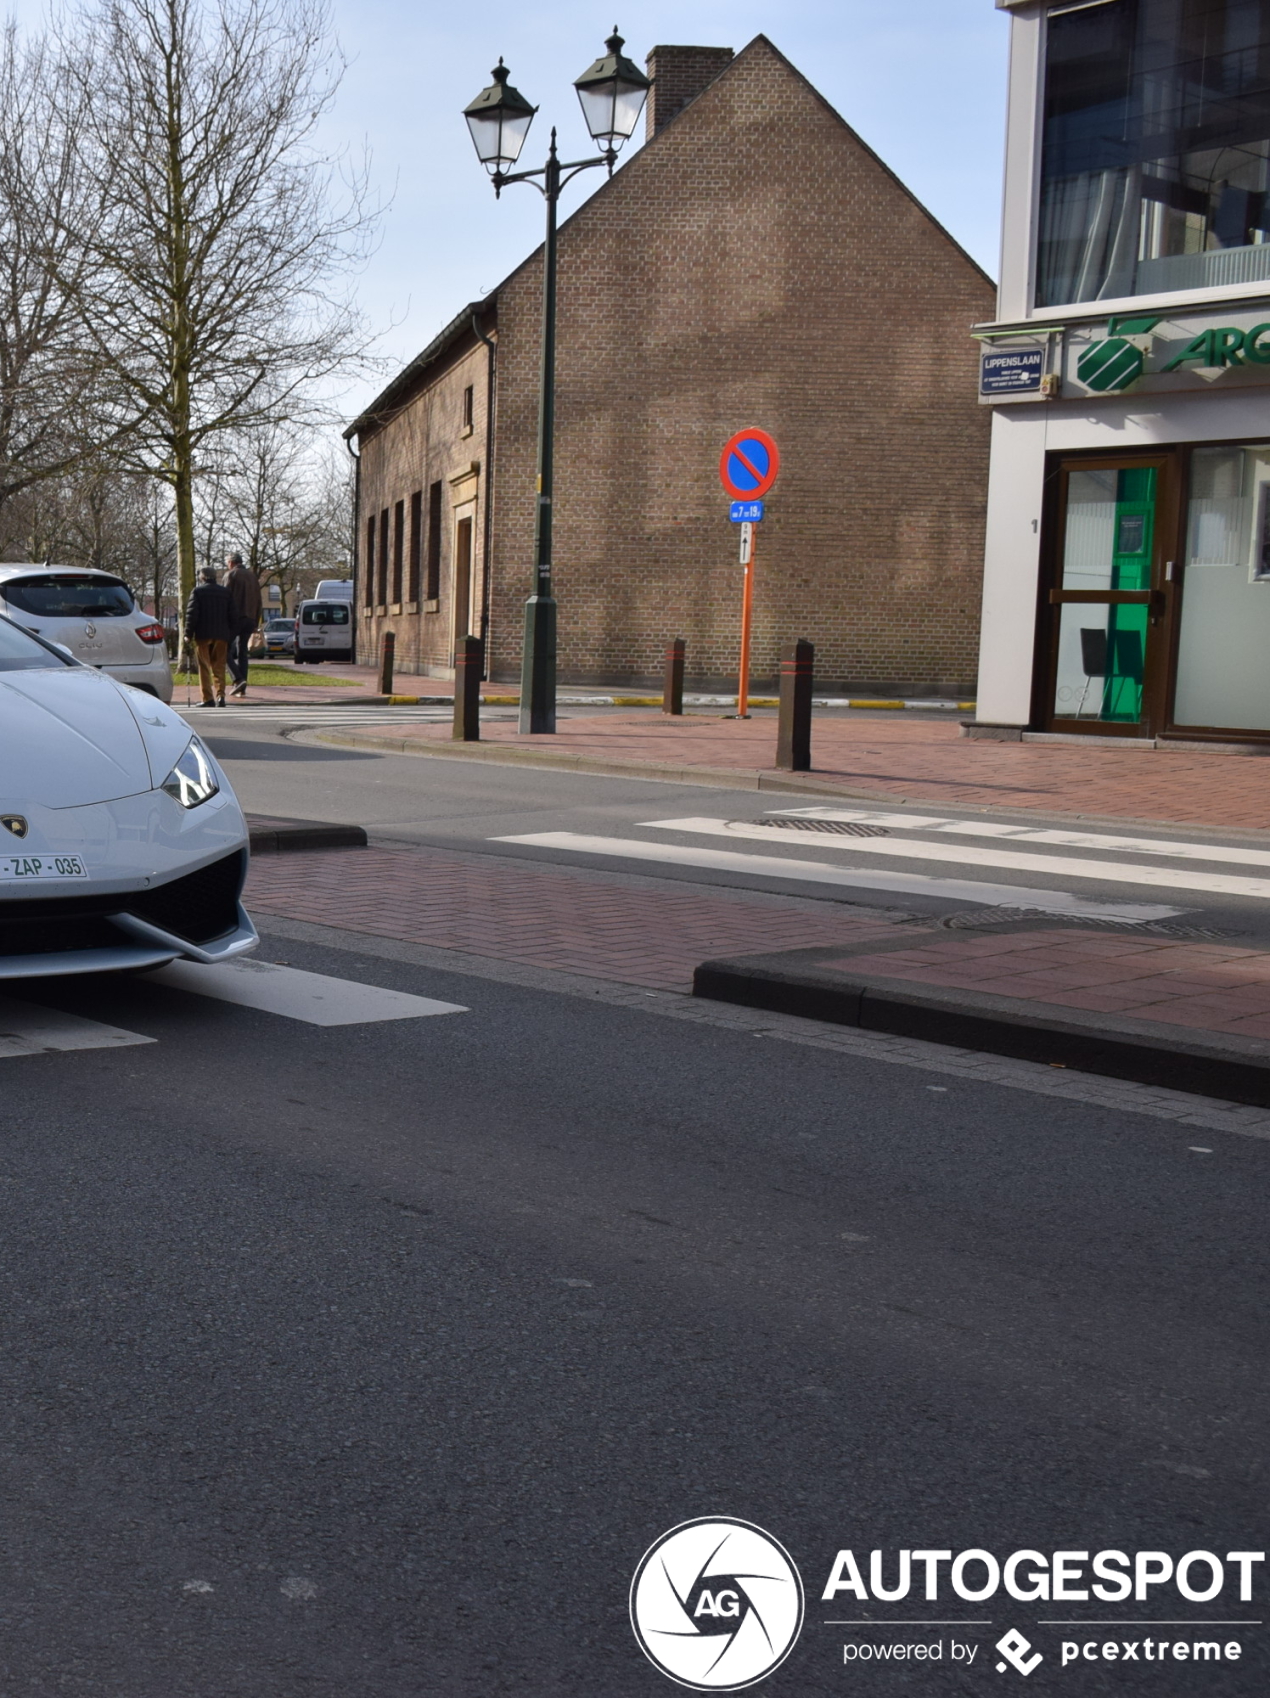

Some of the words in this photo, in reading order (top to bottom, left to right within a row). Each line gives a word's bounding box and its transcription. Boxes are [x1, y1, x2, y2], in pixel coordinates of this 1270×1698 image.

[985, 354, 1041, 369] LIPPENSLAAN
[738, 506, 744, 518] 7
[1031, 519, 1038, 534] 1
